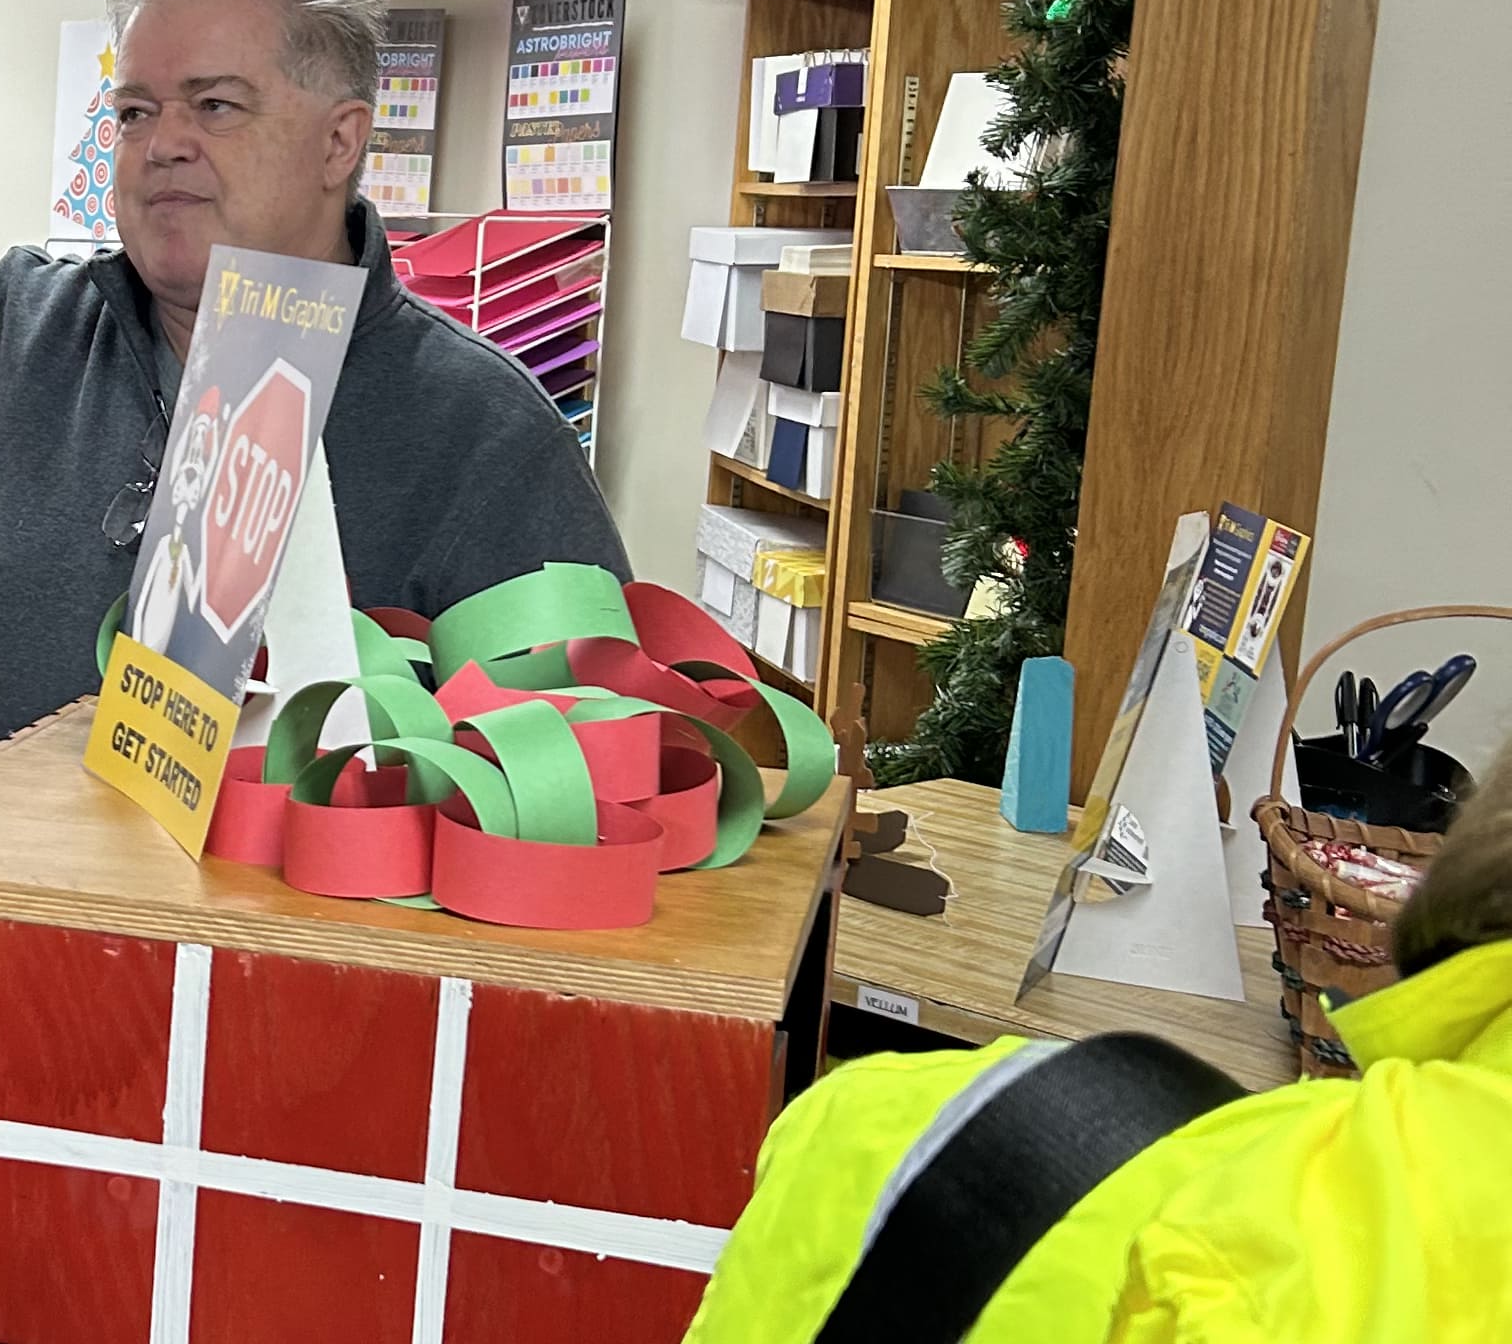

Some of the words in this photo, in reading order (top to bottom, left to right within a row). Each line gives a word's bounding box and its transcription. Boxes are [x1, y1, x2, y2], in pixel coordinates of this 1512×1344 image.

[516, 31, 612, 54] ASTROBRIGHT
[240, 279, 263, 316] Tri
[260, 284, 282, 321] M
[280, 287, 346, 339] Graphics
[215, 434, 292, 565] STOP
[120, 663, 164, 709] STOP
[163, 688, 200, 738] HERE
[198, 713, 219, 752] TO
[112, 721, 146, 764] GET
[145, 742, 202, 812] STARTED
